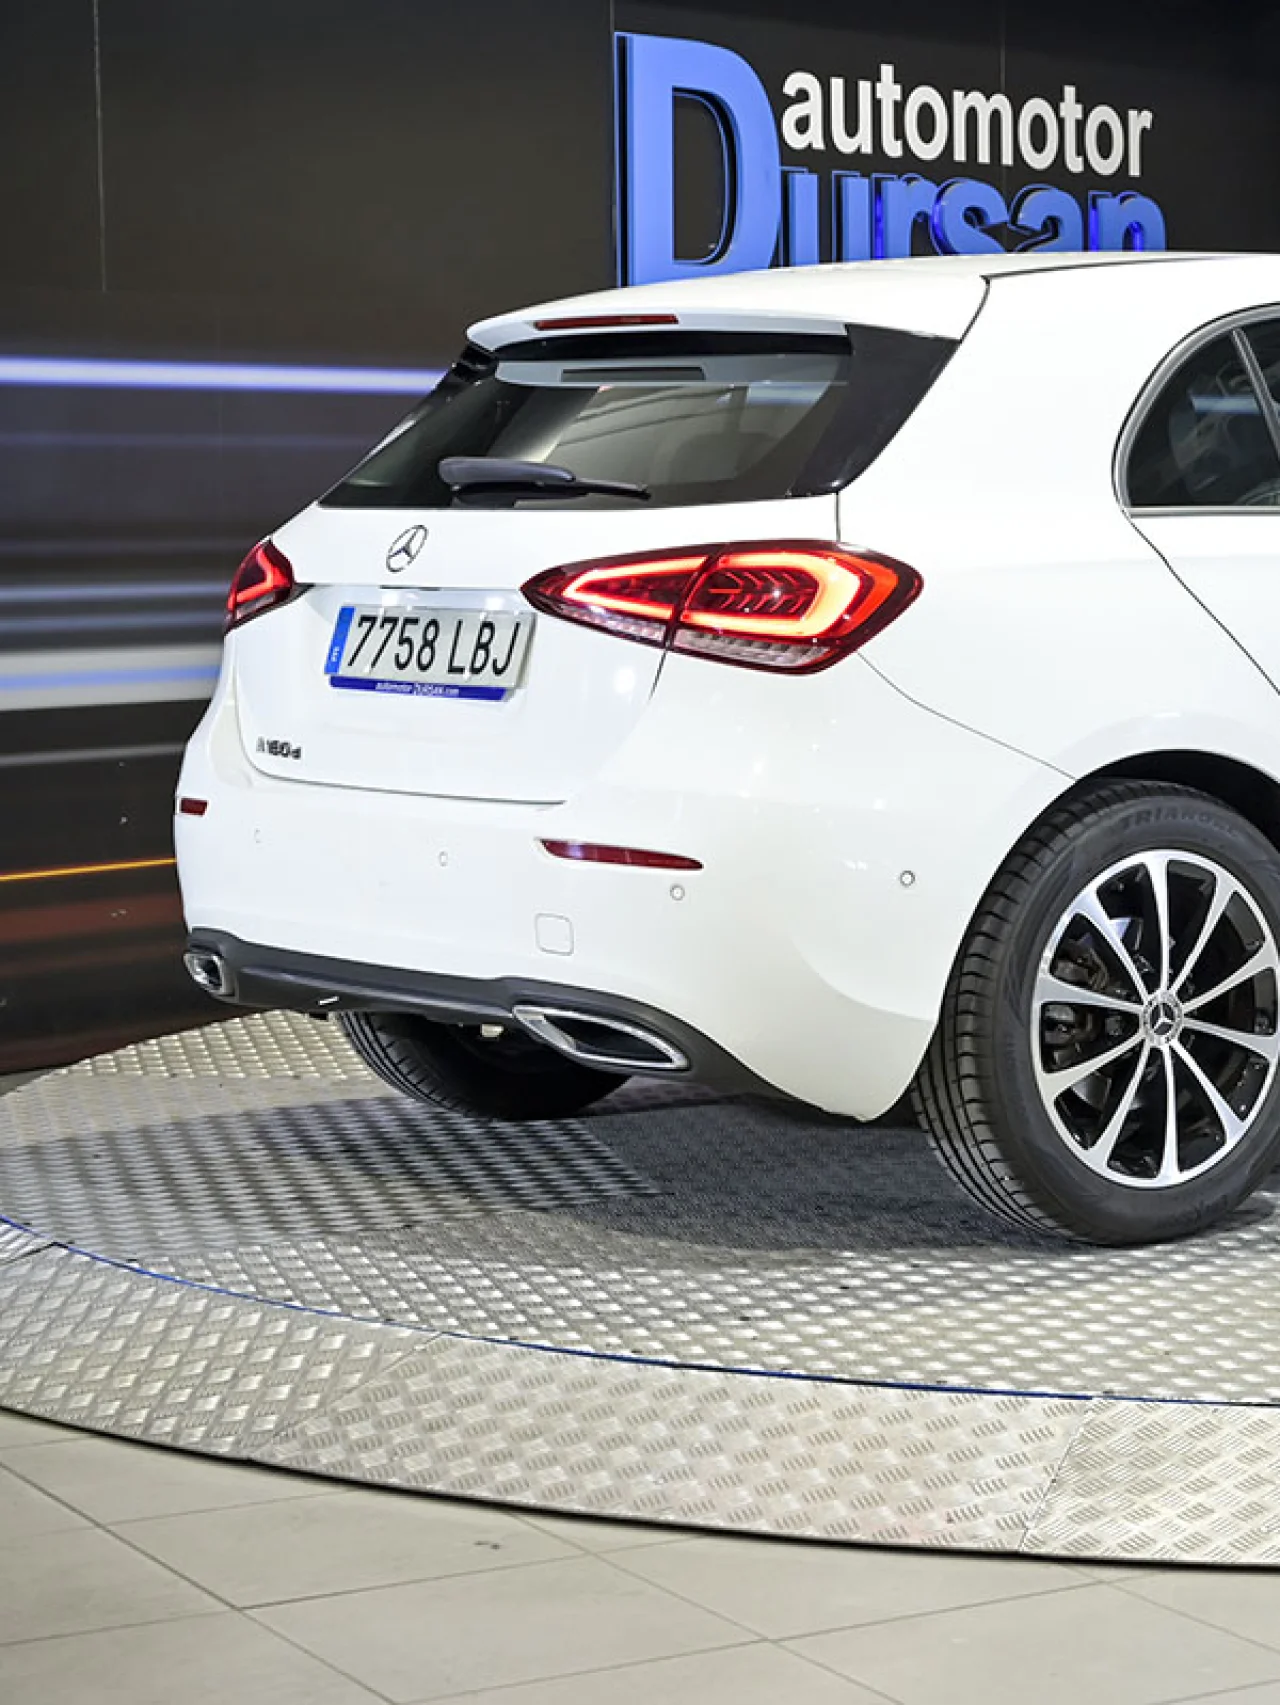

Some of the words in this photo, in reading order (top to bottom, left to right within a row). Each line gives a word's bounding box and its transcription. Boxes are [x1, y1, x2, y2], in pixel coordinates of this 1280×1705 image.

[781, 63, 1153, 178] automotor
[347, 614, 440, 672] 7758
[447, 619, 522, 676] LBJ
